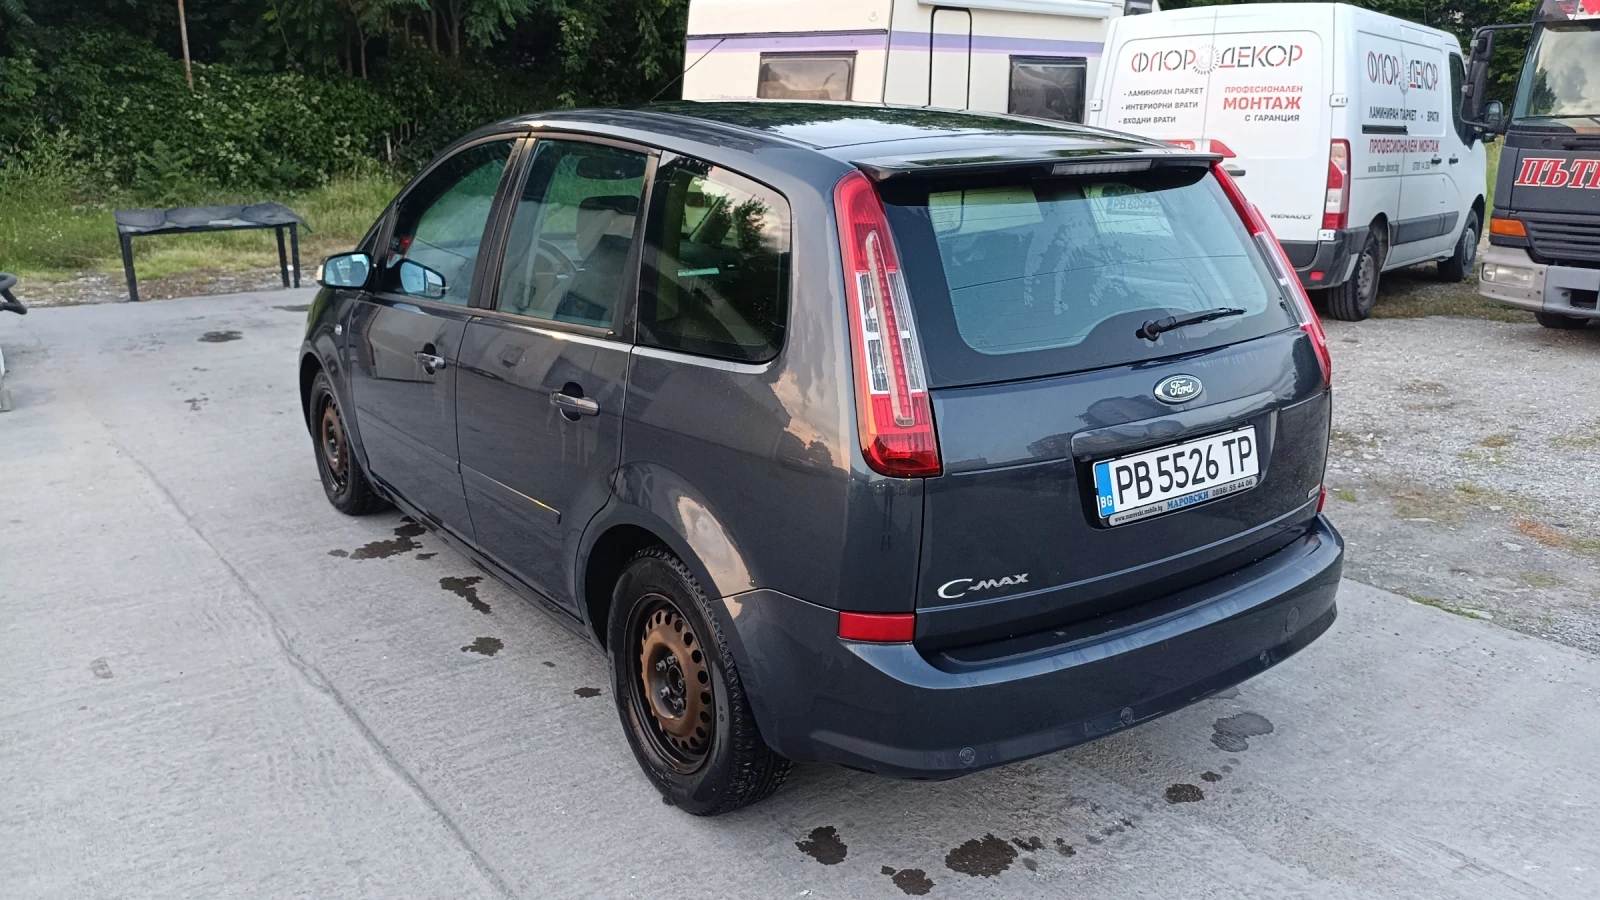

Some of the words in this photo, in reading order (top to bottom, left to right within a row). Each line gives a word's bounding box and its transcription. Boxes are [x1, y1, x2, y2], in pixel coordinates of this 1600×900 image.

[1130, 48, 1197, 73] ФЛОР
[1218, 44, 1304, 68] ДЕКОР
[1367, 50, 1399, 86] ФЛОР
[1409, 59, 1438, 91] ДЕКОР
[1128, 88, 1172, 97] ЛАМИНИРАН
[1174, 87, 1204, 95] ПАРКЕТ
[1224, 86, 1304, 94] ПРОФЕСИОНАЛЕН
[1125, 102, 1172, 110] ИНТЕРИОРНИ
[1222, 96, 1302, 110] МОНТАЖ
[1254, 114, 1300, 122] ГАРАНЦИЯ
[1170, 380, 1194, 396] Ford
[1116, 460, 1153, 505] PB
[1156, 444, 1220, 493] 5526
[1222, 436, 1252, 475] TP
[1100, 495, 1112, 508] BG
[937, 572, 1029, 599] C-MAX
